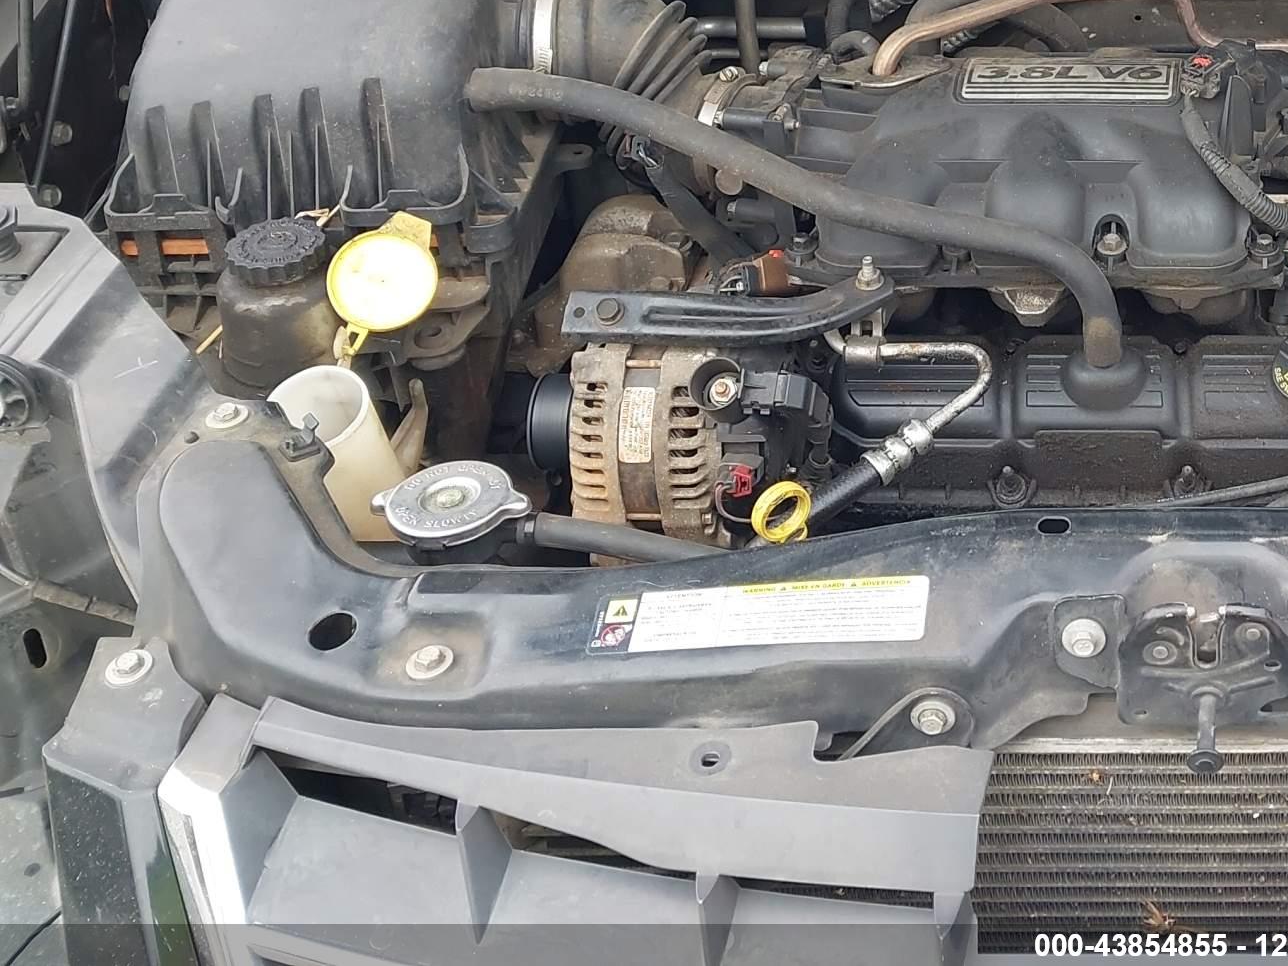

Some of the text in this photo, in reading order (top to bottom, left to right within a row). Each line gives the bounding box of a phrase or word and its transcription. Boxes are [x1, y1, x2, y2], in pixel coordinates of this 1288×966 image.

[977, 65, 1163, 80] 3.8L V6
[1274, 366, 1283, 383] SAE
[404, 477, 423, 491] DO
[425, 466, 451, 479] NOT
[395, 506, 477, 528] OPEN SLOWLY
